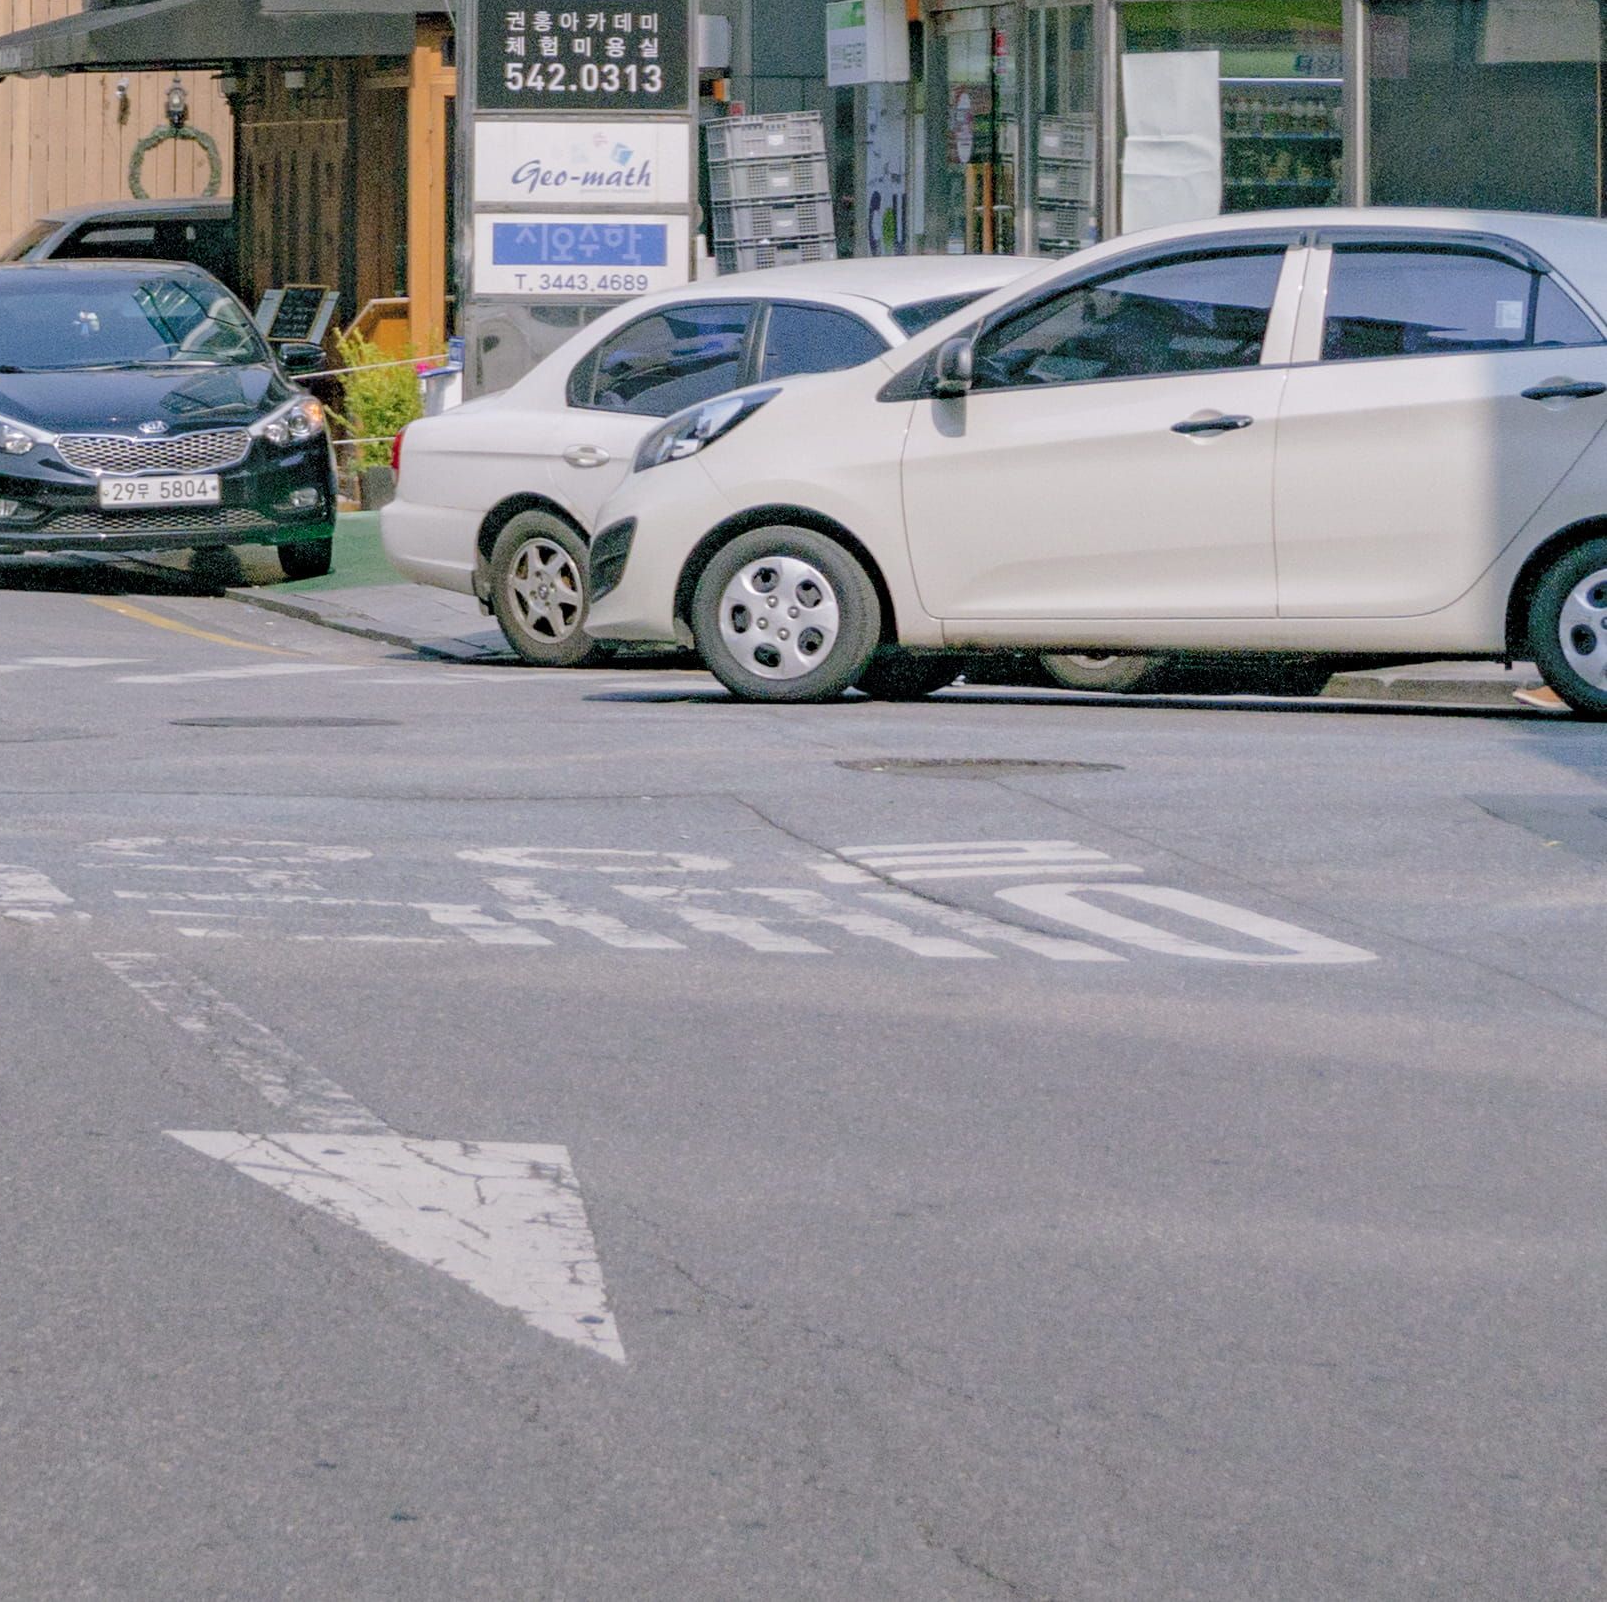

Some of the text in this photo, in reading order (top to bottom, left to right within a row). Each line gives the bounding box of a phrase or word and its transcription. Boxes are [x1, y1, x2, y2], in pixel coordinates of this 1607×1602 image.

[505, 11, 658, 33] 권홍아카데미
[505, 36, 658, 59] 체험미용실
[505, 62, 663, 93] 542.0313
[510, 159, 652, 194] Geo-math
[539, 274, 649, 292] 3443.4689
[155, 479, 209, 502] 5804
